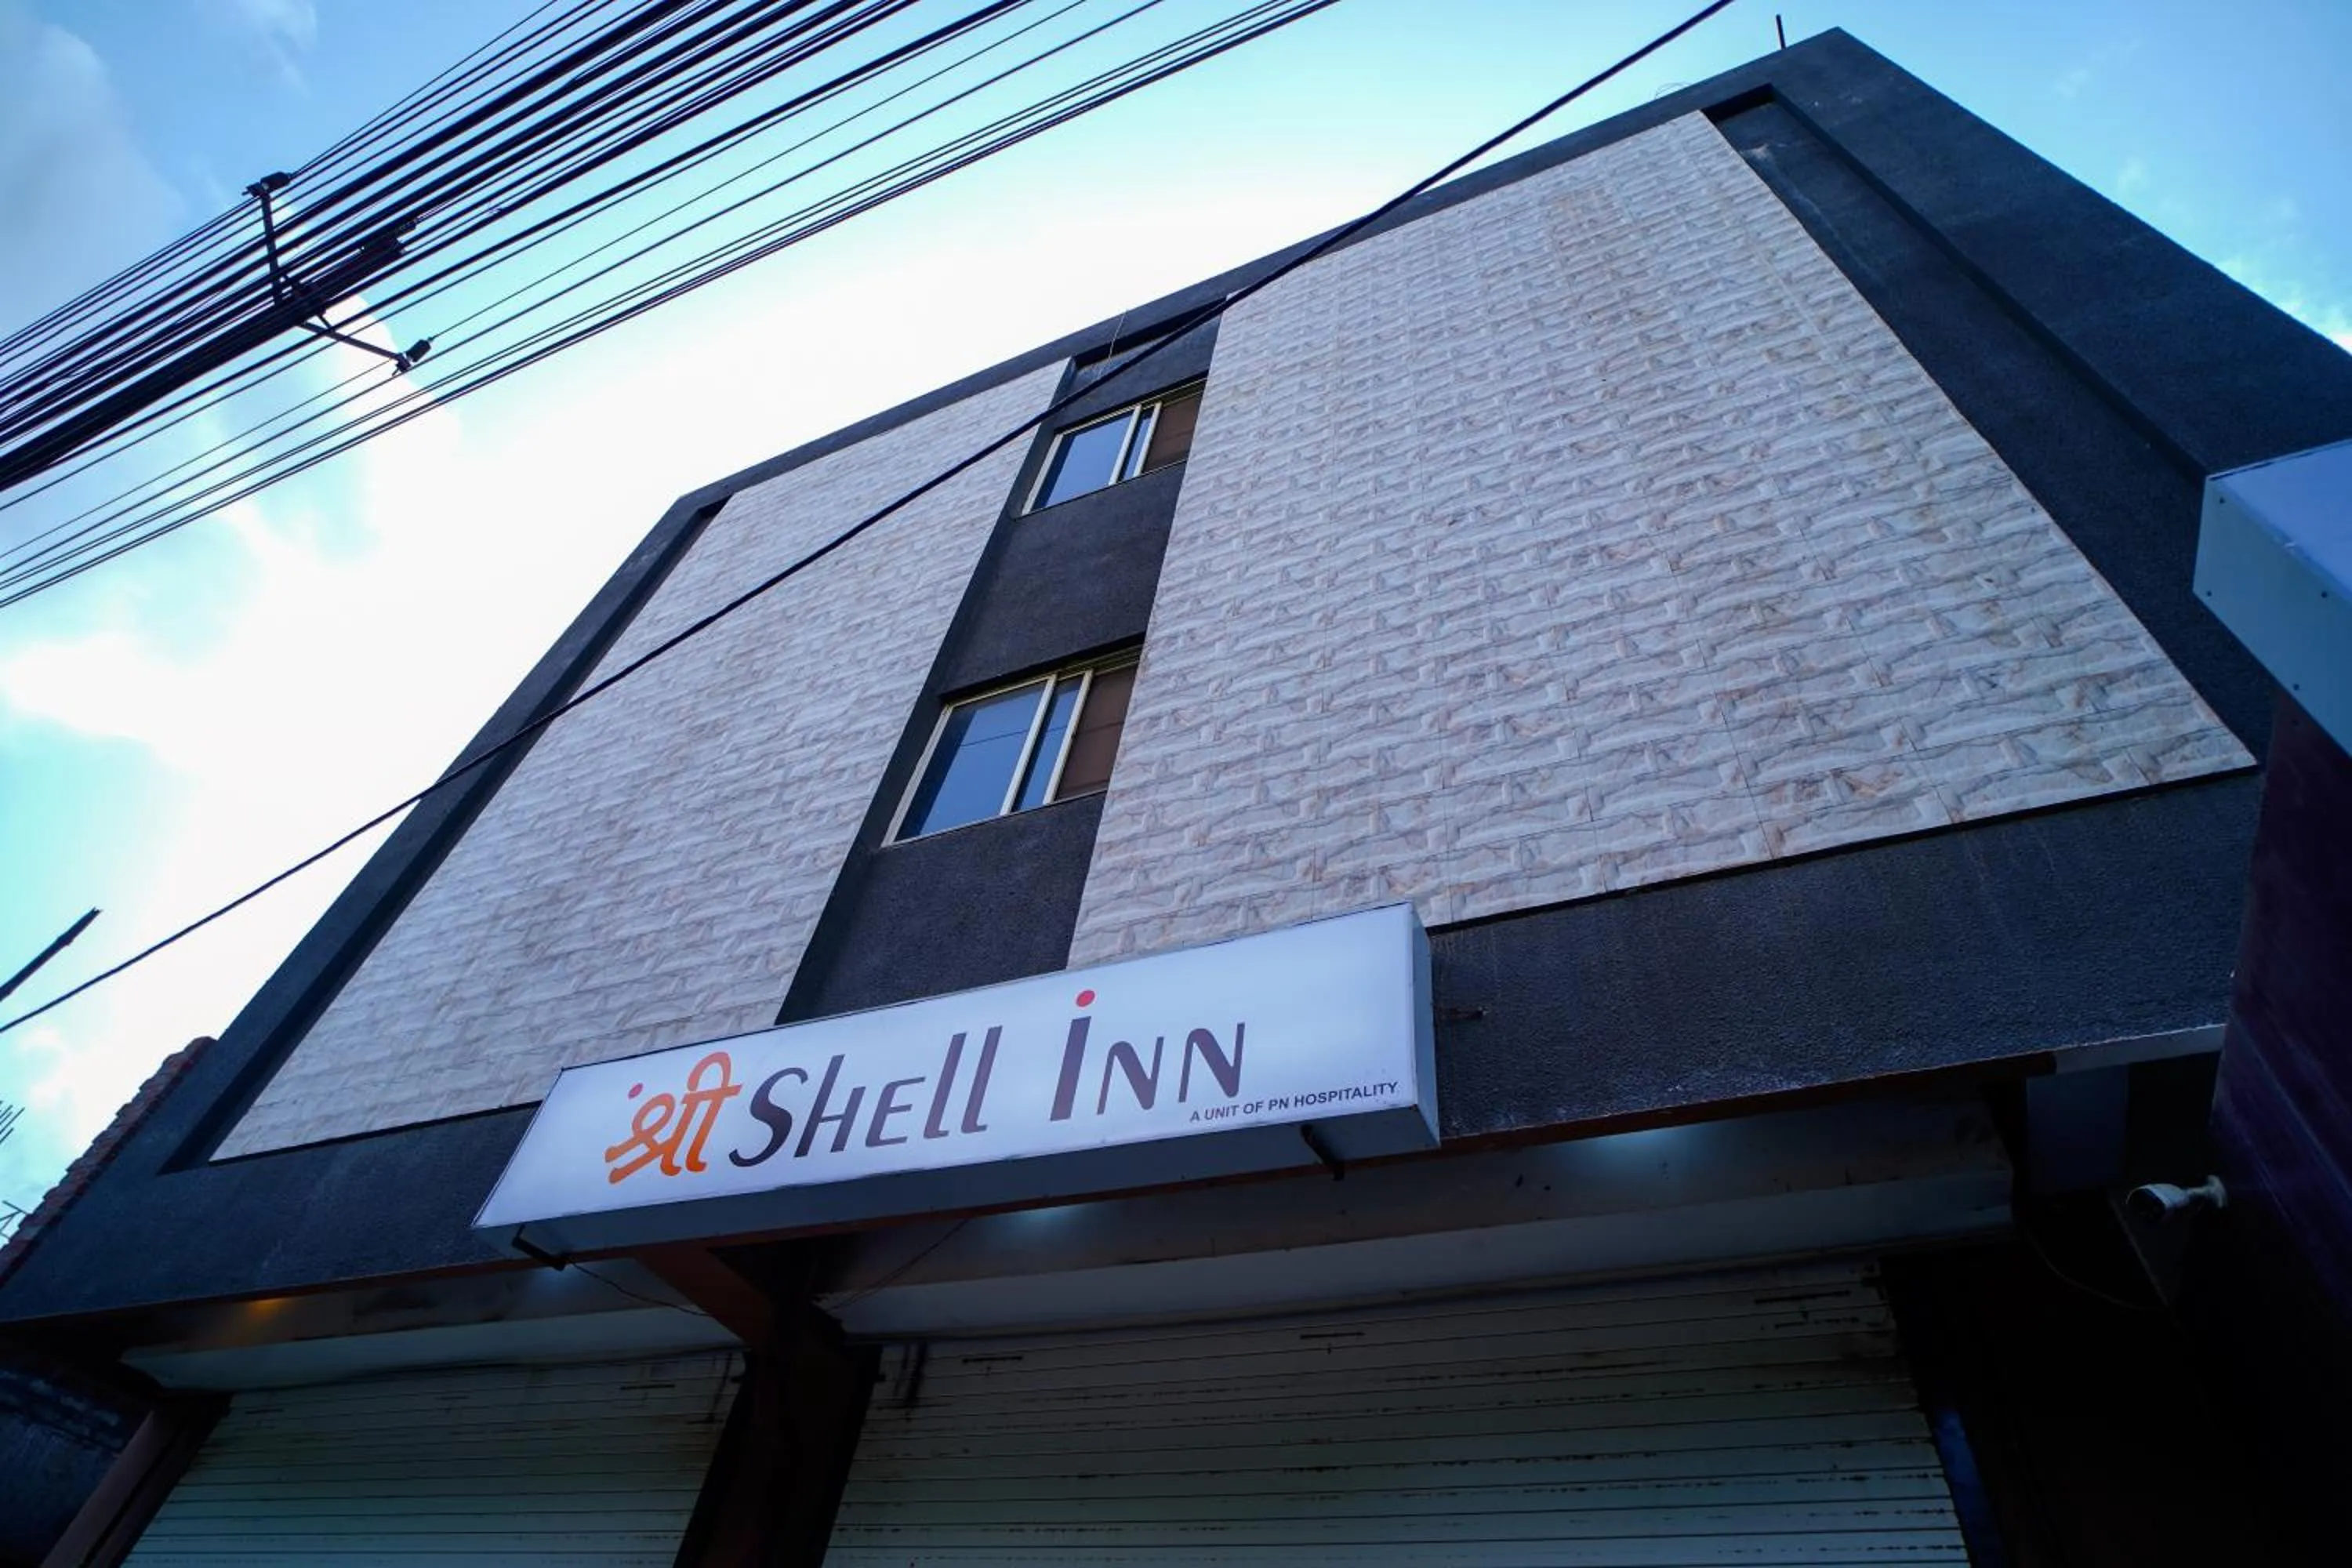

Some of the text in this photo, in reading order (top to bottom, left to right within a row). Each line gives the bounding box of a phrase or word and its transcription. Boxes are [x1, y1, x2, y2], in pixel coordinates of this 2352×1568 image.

[604, 1051, 742, 1185] श्री
[1189, 1081, 1398, 1123] A UNIT OF PN HOSPITALITY
